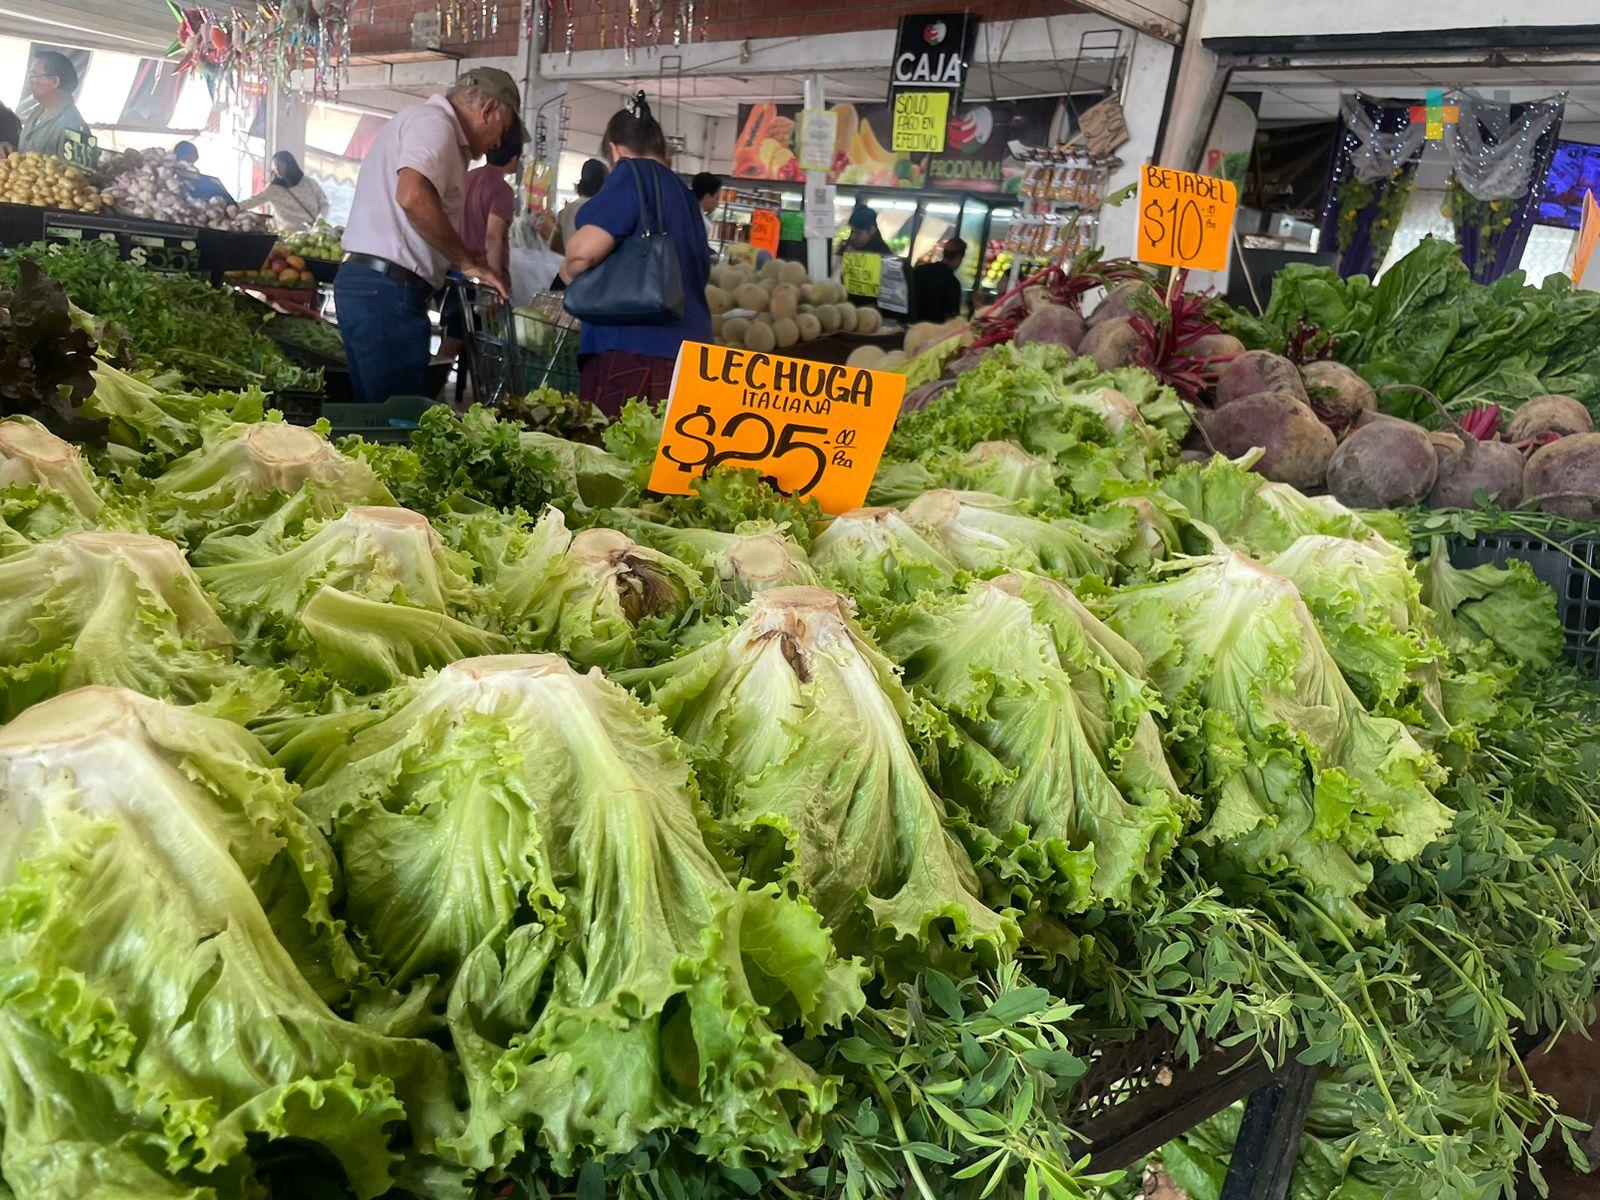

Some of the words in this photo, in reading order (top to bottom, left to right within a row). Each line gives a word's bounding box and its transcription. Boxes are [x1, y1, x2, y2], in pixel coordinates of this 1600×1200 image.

[896, 52, 960, 81] CAJA
[896, 95, 928, 115] SOLO
[1147, 166, 1229, 204] BETABEL
[700, 346, 873, 407] LECHUGA
[742, 389, 831, 415] ITALIANA
